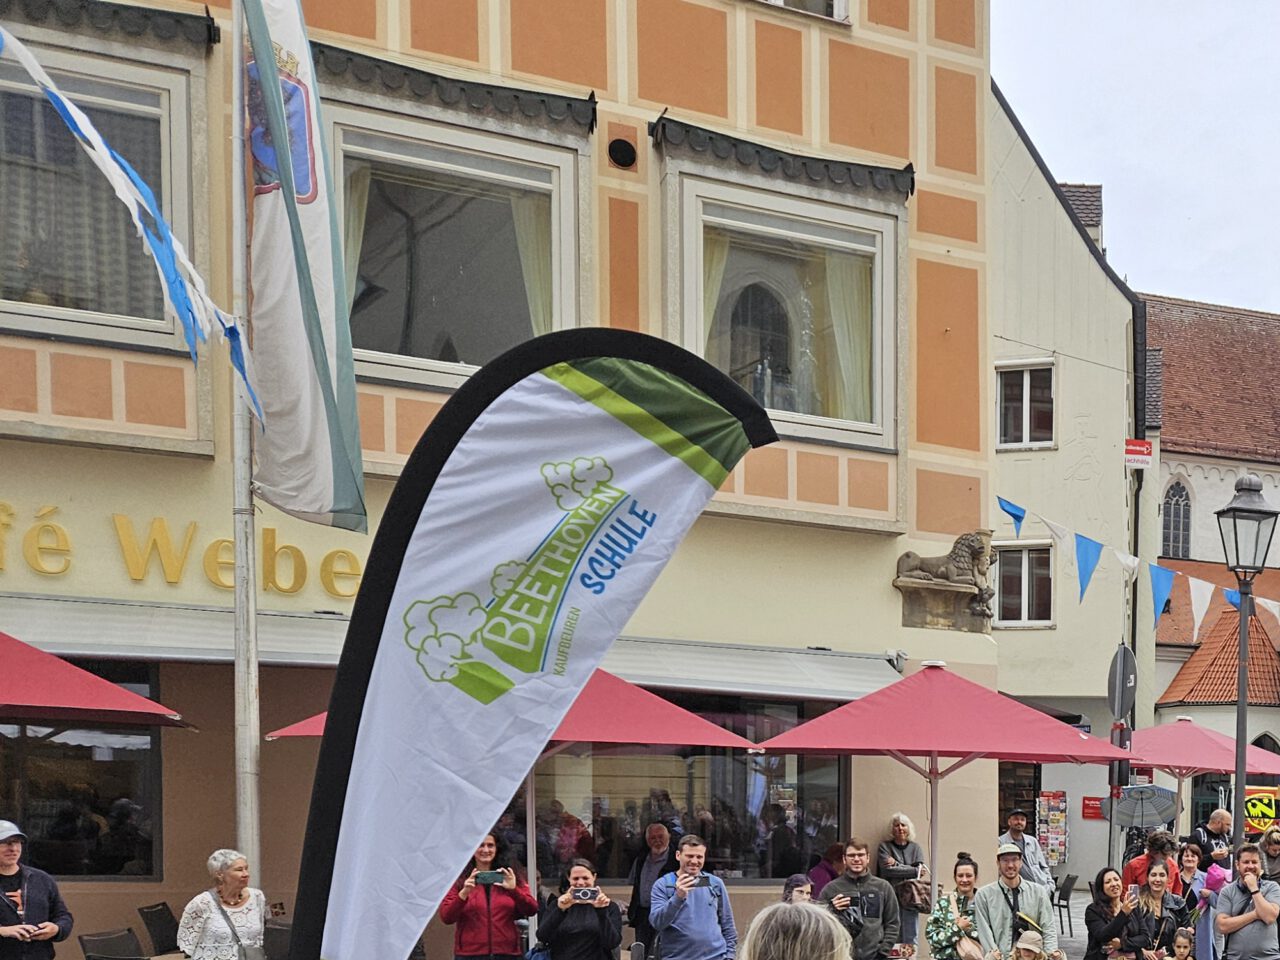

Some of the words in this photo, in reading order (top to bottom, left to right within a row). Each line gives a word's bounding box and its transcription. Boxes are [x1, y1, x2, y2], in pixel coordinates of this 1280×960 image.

[482, 486, 622, 652] BEETHOVEN
[580, 499, 657, 595] SCHULE
[552, 606, 582, 677] KAUFBEUREN
